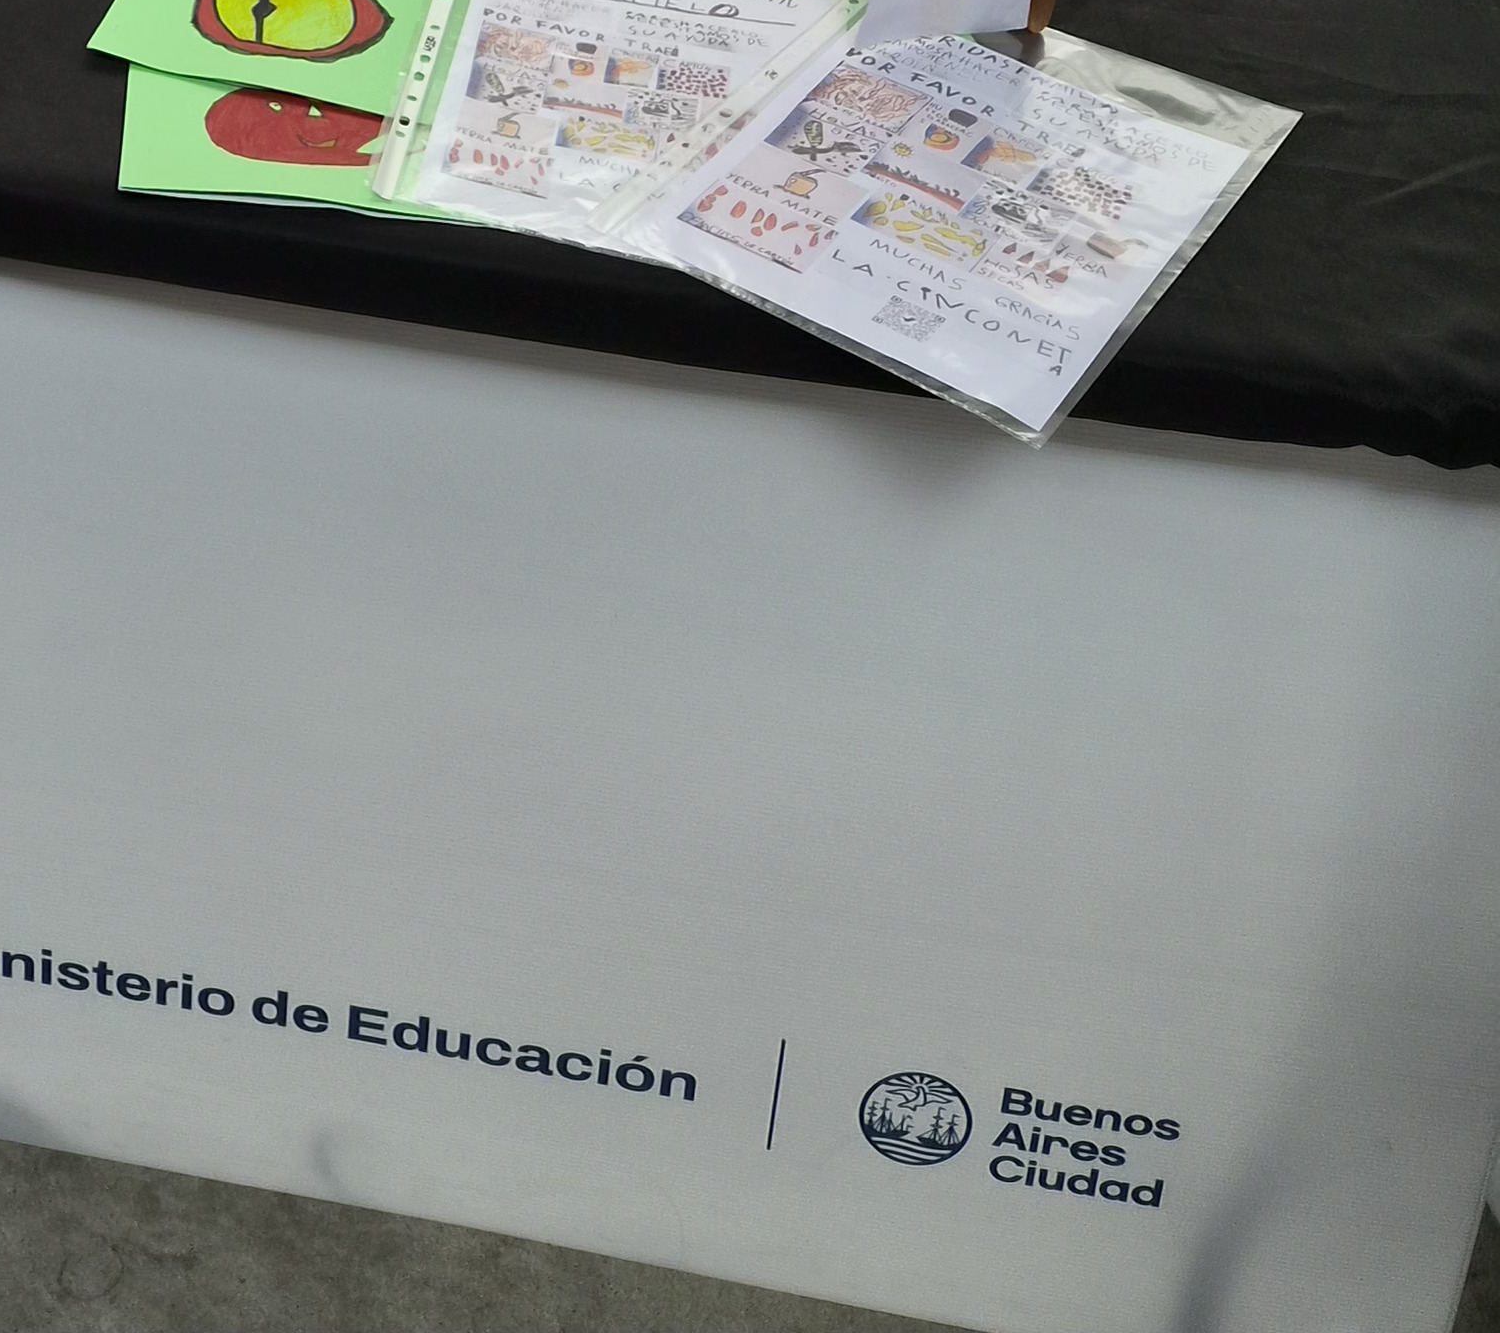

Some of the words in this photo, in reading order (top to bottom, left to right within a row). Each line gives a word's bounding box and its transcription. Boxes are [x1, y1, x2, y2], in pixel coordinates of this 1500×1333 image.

[483, 8, 522, 25] POR
[536, 20, 606, 43] FAVOR
[910, 71, 996, 118] FAVOR
[781, 198, 840, 225] MATE
[869, 238, 967, 291] MUCHAS
[250, 990, 330, 1034] de
[346, 1005, 699, 1102] Educación
[1000, 1087, 1181, 1141] Buenos
[992, 1122, 1127, 1166] Aires
[989, 1155, 1165, 1208] Ciudad
